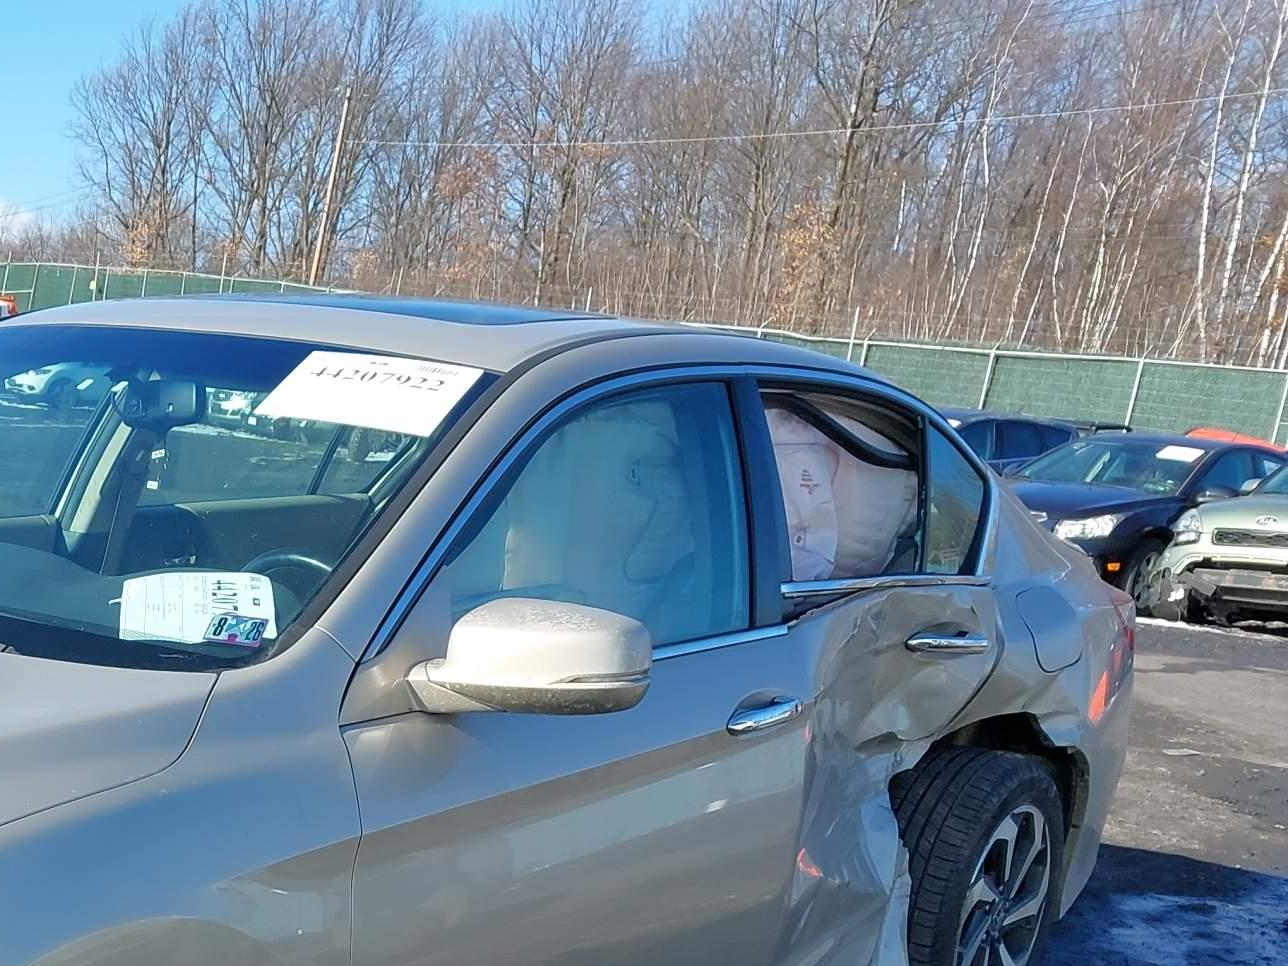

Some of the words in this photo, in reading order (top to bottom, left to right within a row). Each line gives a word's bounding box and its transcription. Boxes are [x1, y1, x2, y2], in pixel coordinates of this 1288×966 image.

[310, 366, 446, 392] 44207922
[213, 616, 228, 637] 8
[245, 621, 265, 642] 26
